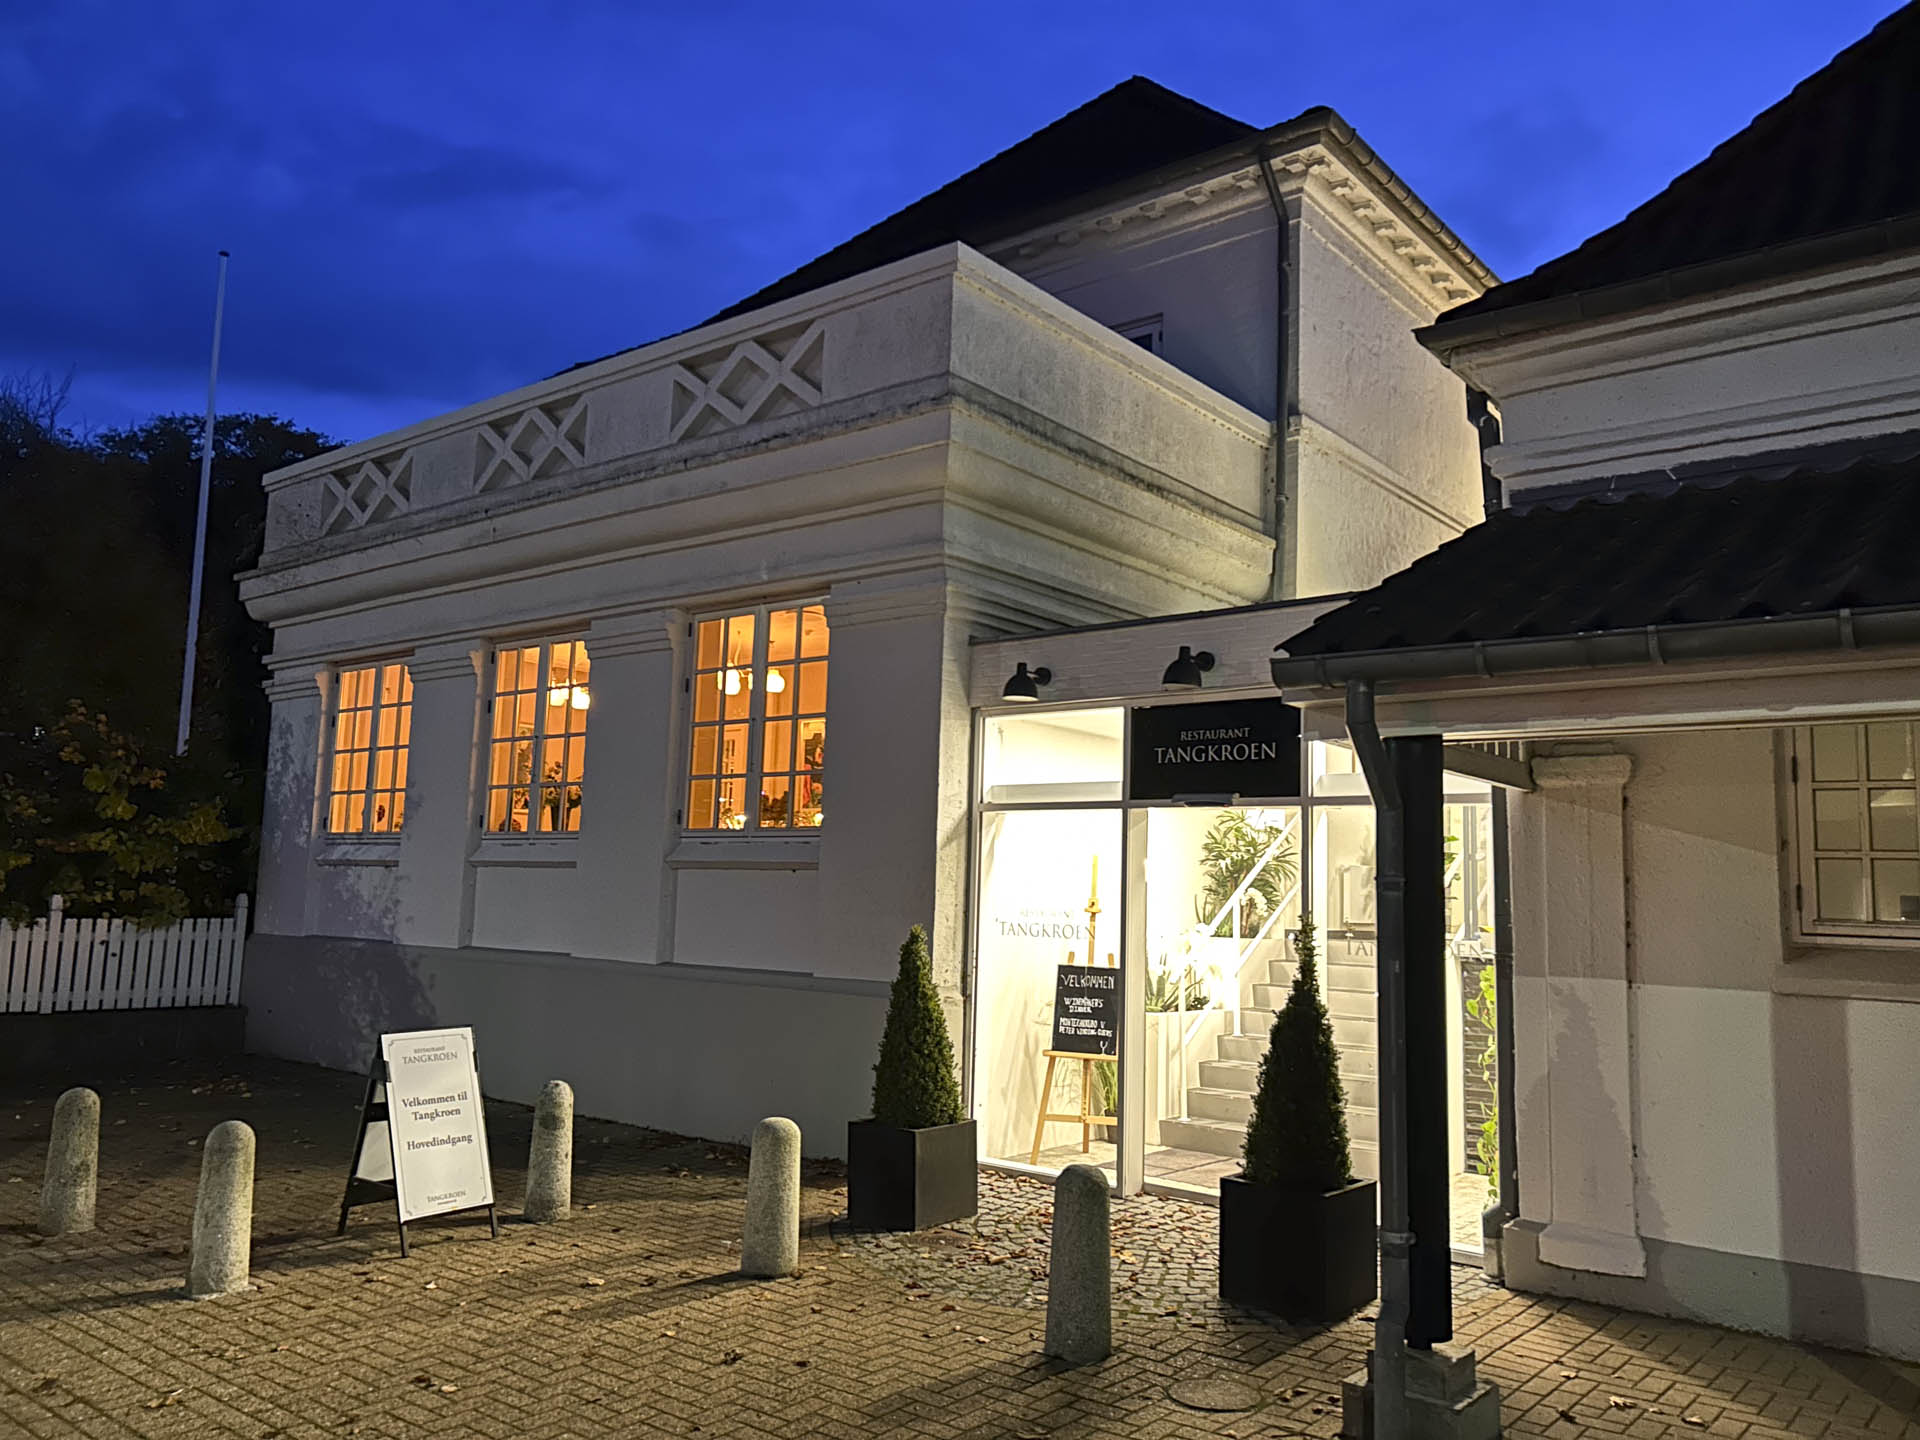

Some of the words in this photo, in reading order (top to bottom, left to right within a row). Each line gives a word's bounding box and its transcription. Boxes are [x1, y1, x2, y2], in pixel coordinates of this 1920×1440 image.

[1180, 728, 1251, 741] RESTAURANT
[1154, 742, 1276, 764] TANGKROEN
[1000, 920, 1095, 939] TANGKROEN
[1060, 974, 1115, 990] VELKOMMEN
[402, 1052, 458, 1064] TANGKROEN
[402, 1095, 456, 1108] Velkommen
[457, 1090, 468, 1101] til
[411, 1108, 461, 1122] Tangkroen
[407, 1134, 473, 1151] Hovedindgang
